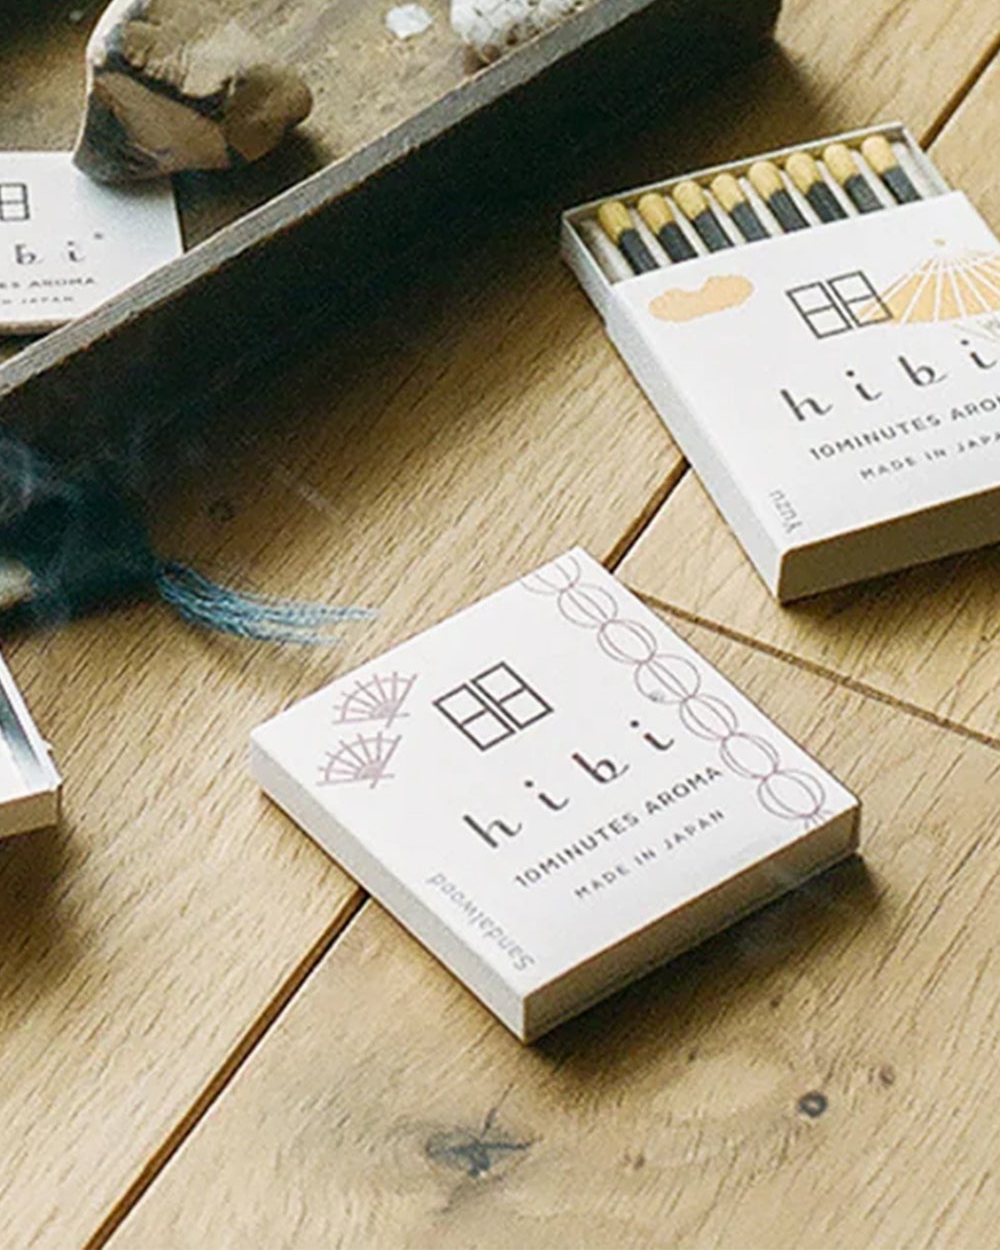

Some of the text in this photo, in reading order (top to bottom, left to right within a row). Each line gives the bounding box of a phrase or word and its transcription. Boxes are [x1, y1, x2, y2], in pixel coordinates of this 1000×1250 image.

[780, 338, 998, 422] hibi
[809, 413, 941, 461] 10MINUTES
[859, 456, 917, 481] MADE
[924, 448, 947, 462] IN
[769, 489, 803, 534] Yuzu
[462, 719, 675, 850] hibi
[514, 766, 723, 888] 10MINUTES AROMA
[573, 809, 725, 900] MADE IN JAPAN
[426, 873, 535, 971] Sandalwood
